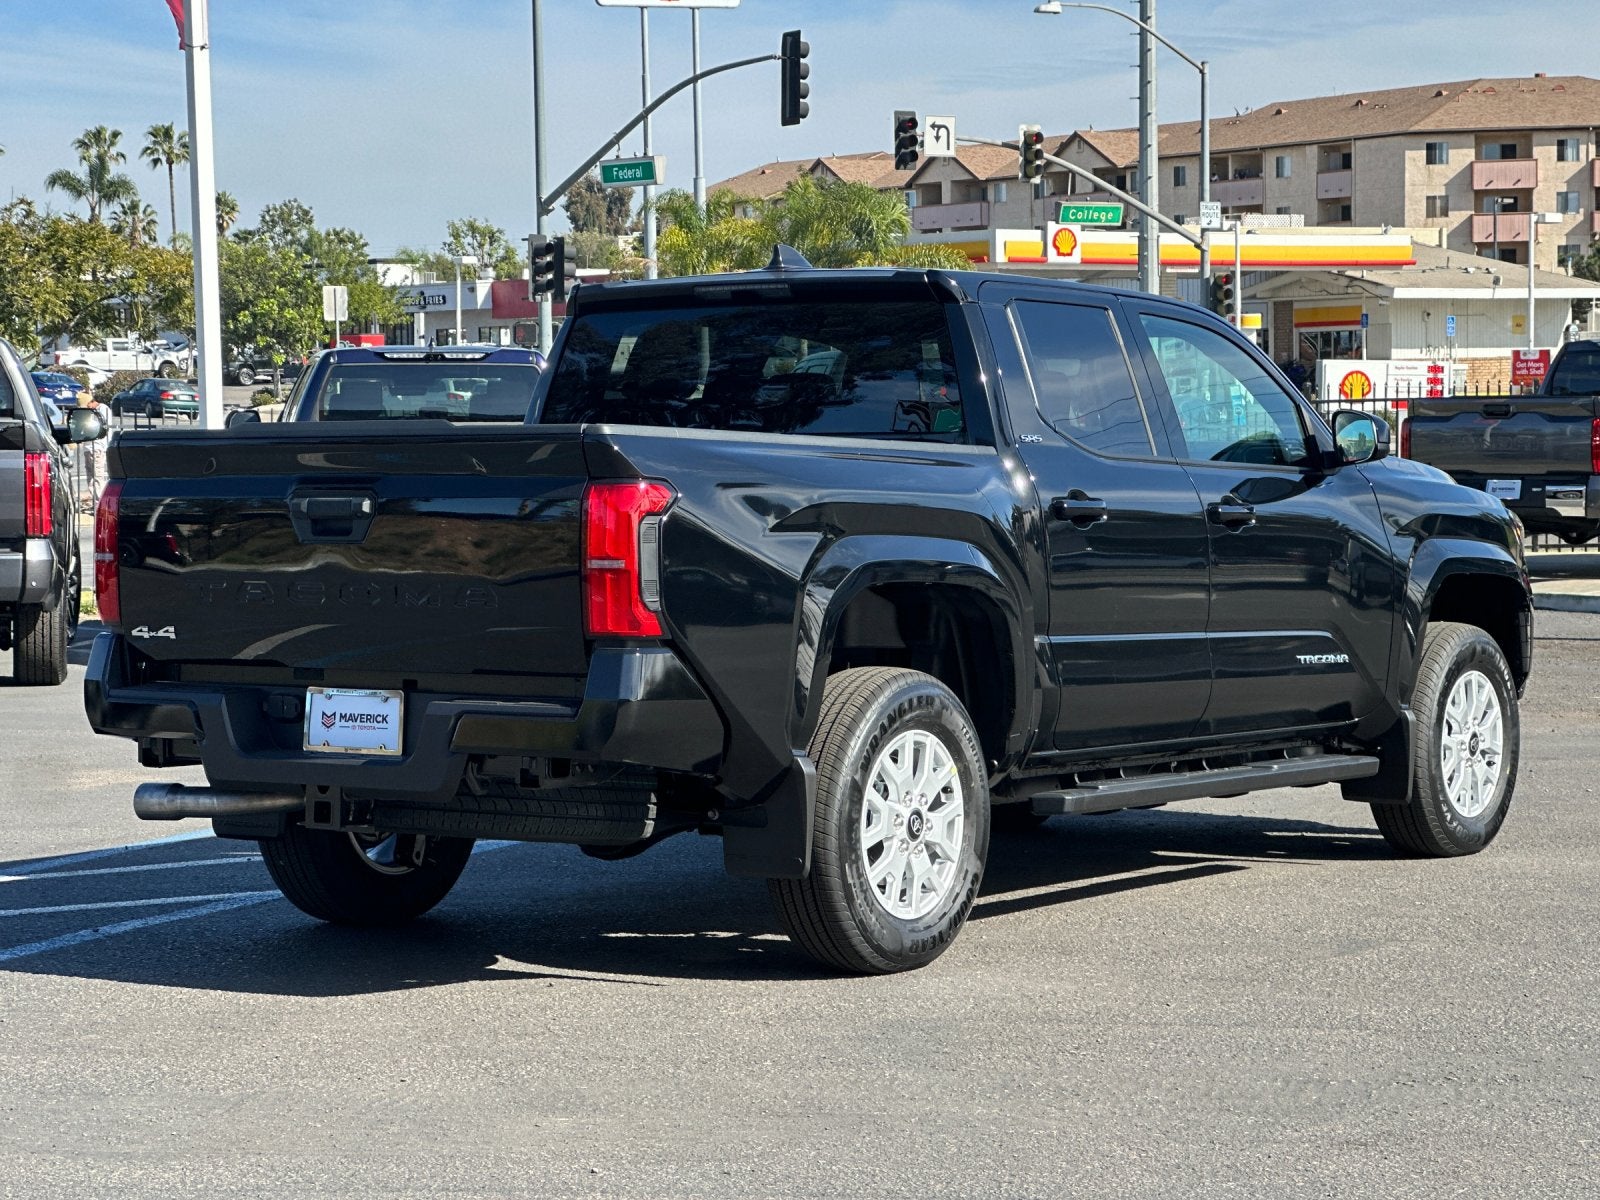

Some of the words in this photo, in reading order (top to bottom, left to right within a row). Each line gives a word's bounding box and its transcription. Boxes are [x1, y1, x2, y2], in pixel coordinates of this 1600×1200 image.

[612, 166, 643, 180] Federal
[1069, 208, 1114, 223] College
[1201, 211, 1219, 219] ROUTE
[1295, 653, 1350, 664] TACOMA
[339, 712, 389, 724] MAVERICK
